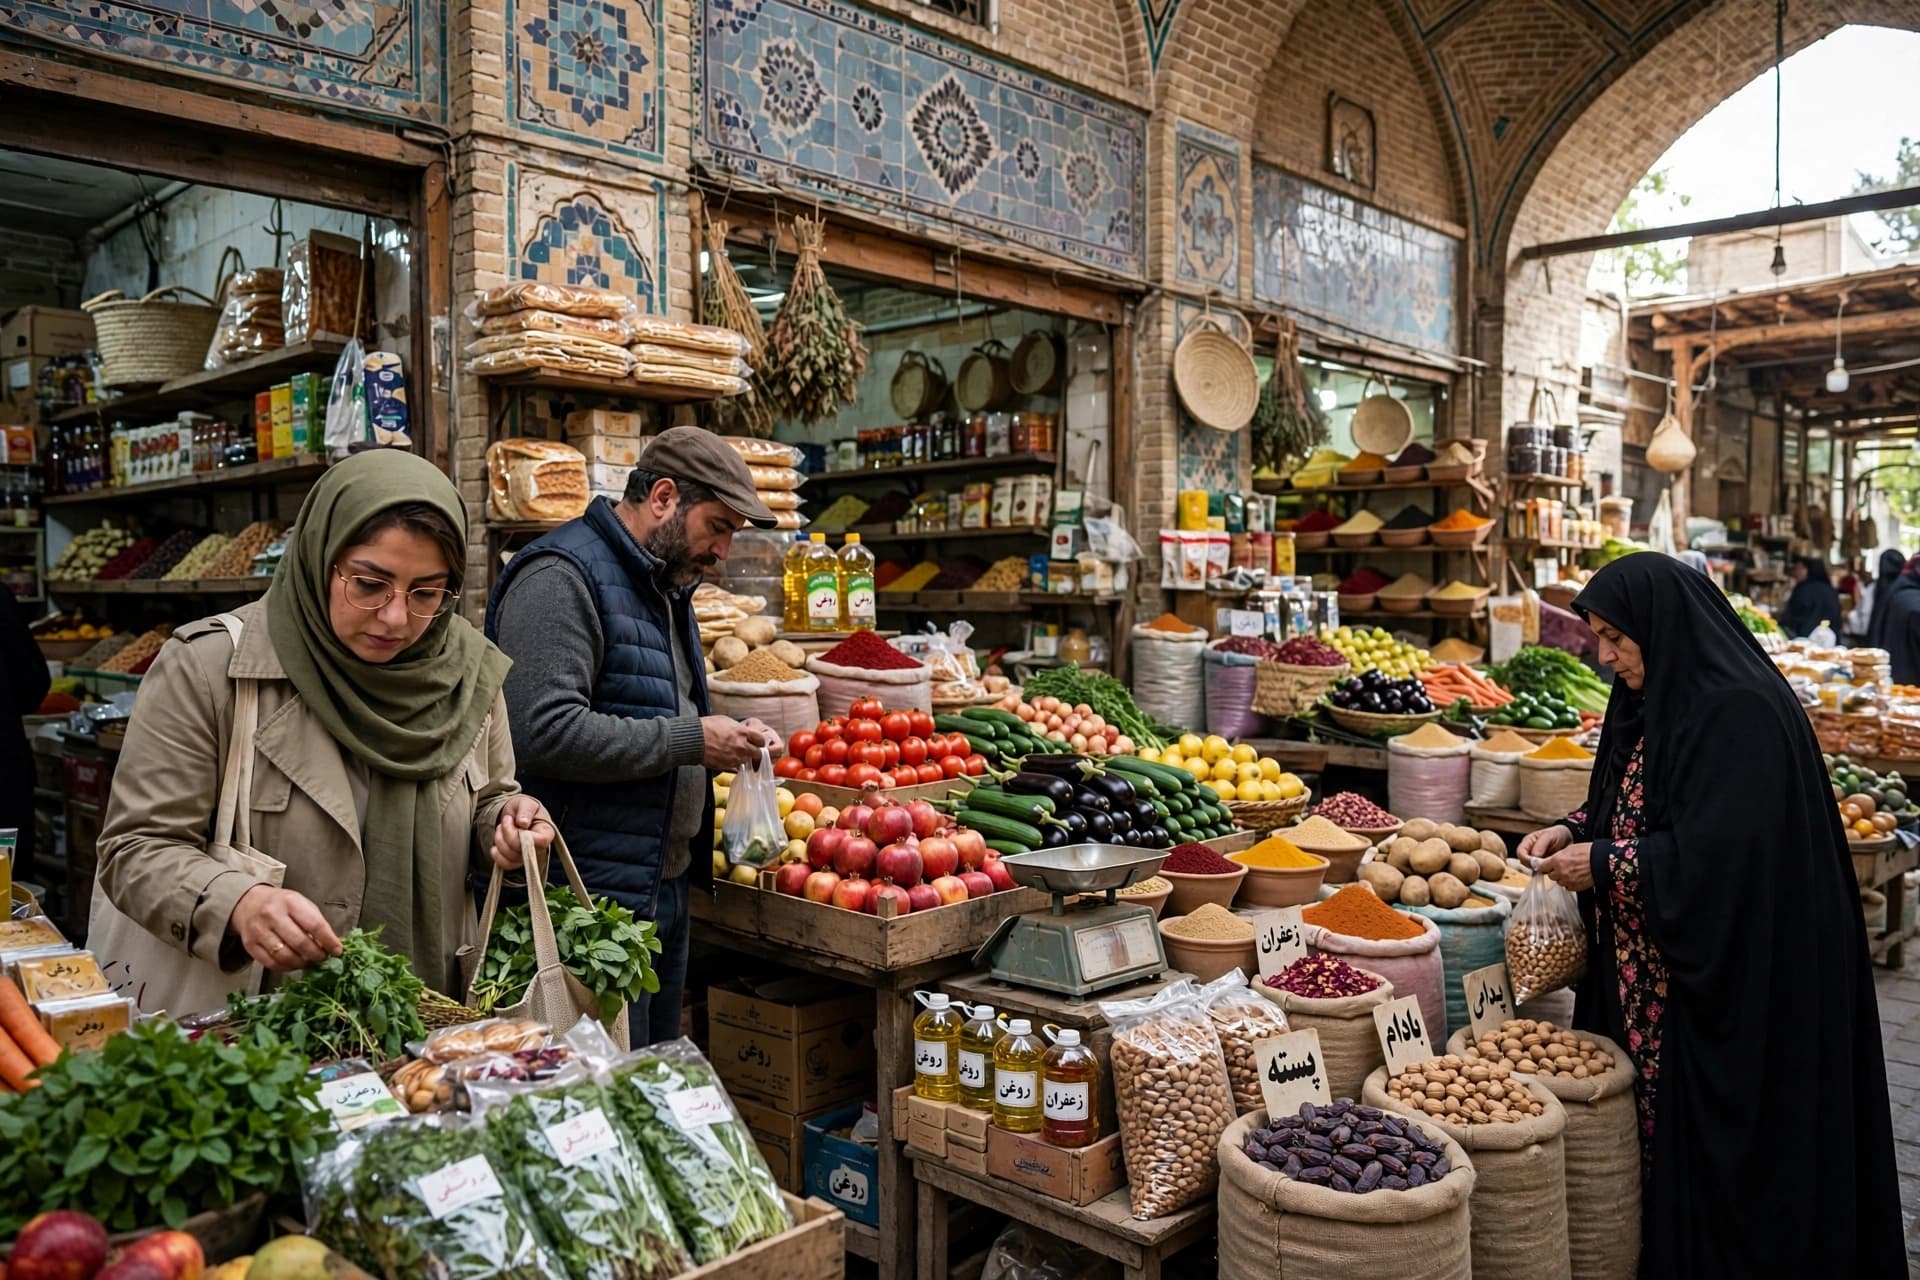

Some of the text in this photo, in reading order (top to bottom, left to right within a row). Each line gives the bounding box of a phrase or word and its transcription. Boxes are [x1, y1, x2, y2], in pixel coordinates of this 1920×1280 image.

[1261, 924, 1300, 954] زعفران
[1386, 1007, 1424, 1058] بادام
[737, 1039, 771, 1067] روغن
[916, 1049, 942, 1068] روغن
[1268, 1051, 1321, 1091] پسته
[1000, 1080, 1031, 1099] روغن
[1045, 1091, 1084, 1111] زعفران
[832, 1172, 865, 1200] روغن
